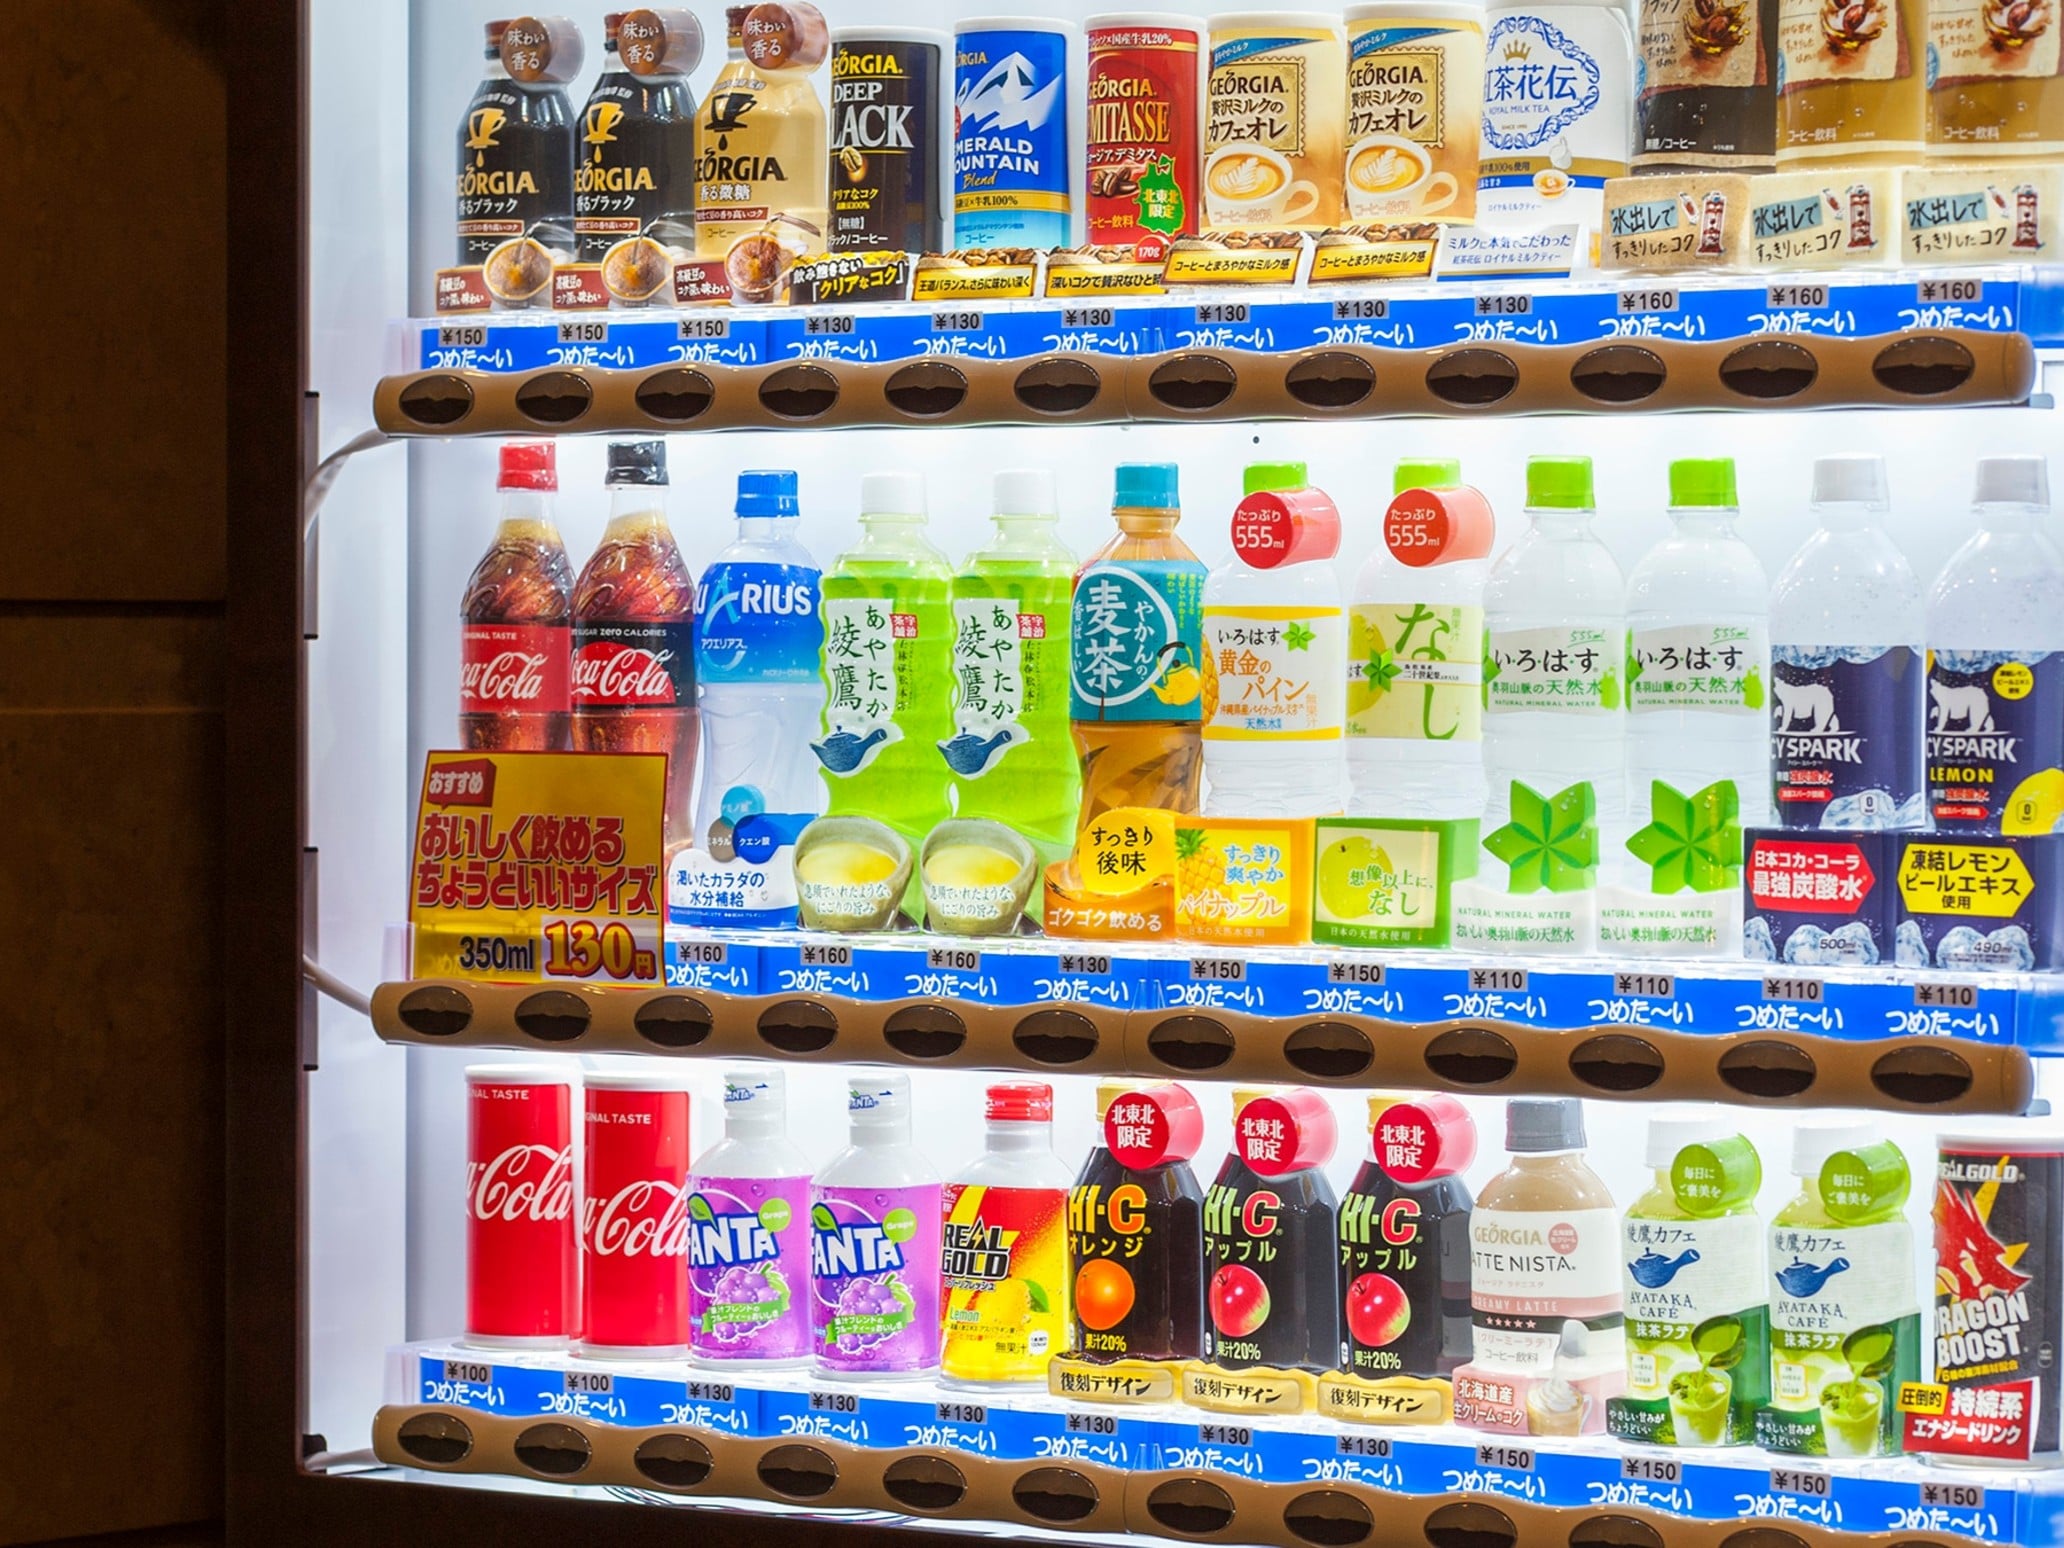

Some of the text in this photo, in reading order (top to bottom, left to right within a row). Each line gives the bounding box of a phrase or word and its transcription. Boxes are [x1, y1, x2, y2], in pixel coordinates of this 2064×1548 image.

[508, 30, 545, 45] 味わい
[624, 23, 659, 38] 味わい
[747, 20, 785, 37] 味わい
[627, 45, 655, 64] 香る
[752, 39, 782, 57] 香る
[512, 53, 540, 70] 香る
[1210, 70, 1285, 95] GEORGIA
[1350, 63, 1424, 88] GEORGIA
[834, 82, 882, 103] DEEP
[1351, 90, 1423, 107] 贅沢ミルクの
[1212, 98, 1284, 116] 贅沢ミルクの
[1511, 105, 1528, 113] MILK
[831, 105, 914, 148] LACK
[1209, 118, 1288, 142] カフェオレ
[1349, 110, 1429, 135] カフェオレ
[963, 171, 997, 190] Blend
[1144, 190, 1178, 203] 北東北
[1148, 204, 1174, 218] 限定
[1139, 247, 1160, 258] 170g
[1320, 250, 1425, 268] コーヒーとまろやかなミルク感
[1772, 287, 1823, 306] ¥160
[1923, 282, 1975, 300] ¥160
[1337, 302, 1385, 317] ¥130
[1480, 297, 1528, 313] ¥130
[1624, 293, 1673, 309] ¥160
[936, 314, 980, 329] ¥130
[1066, 310, 1110, 325] ¥130
[1200, 306, 1245, 321] ¥130
[562, 325, 603, 340] ¥150
[682, 321, 724, 337] ¥150
[808, 318, 851, 334] ¥130
[441, 331, 482, 344] ¥150
[1237, 509, 1281, 523] たっぷり
[1391, 508, 1436, 522] たっぷり
[1236, 525, 1284, 549] 555ml
[1389, 525, 1440, 548] 555ml
[493, 632, 517, 640] TASTE
[600, 628, 621, 636] zero
[1082, 579, 1132, 693] 麦茶
[702, 638, 746, 651] アクエリアス
[828, 615, 864, 711] 綾鷹
[864, 605, 888, 718] あやたか
[955, 615, 990, 712] 綾鷹
[989, 605, 1014, 720] あやたか
[1219, 649, 1271, 676] 黄金の
[1242, 676, 1310, 702] パイン
[1787, 738, 1862, 764] SPARK
[1943, 738, 2016, 763] SPARK
[429, 771, 483, 794] おすすめ
[1930, 768, 1994, 783] LEMON
[419, 814, 623, 864] おいしく飲める
[739, 838, 770, 846] クエン酸
[1092, 827, 1153, 847] すっきり
[1096, 852, 1146, 875] 後味
[1224, 846, 1281, 865] すっきり
[1755, 851, 1860, 871] 日本コカ・コーラ
[1911, 851, 2009, 873] 凍結レモン
[677, 871, 765, 888] 渇いたカラダの
[1226, 865, 1284, 885] 爽やか
[416, 863, 657, 915] ちょうどいいサイズ
[1753, 871, 1864, 900] 最強炭酸水
[1905, 875, 2021, 896] ピールエキス
[690, 891, 744, 907] 水分補給
[1178, 891, 1286, 919] パイナップル
[1369, 890, 1420, 916] なし
[1942, 896, 1971, 909] 使用
[1049, 908, 1163, 932] ゴクゴク飲める
[1538, 911, 1571, 919] WATER
[1331, 926, 1411, 941] 日本の天然水使用
[459, 920, 656, 980] 350ml 130円
[680, 946, 722, 961] ¥160
[804, 948, 847, 963] ¥160
[932, 951, 975, 969] ¥160
[1062, 956, 1108, 973] ¥130
[1194, 961, 1240, 978] ¥150
[1333, 964, 1380, 981] ¥150
[1474, 971, 1522, 988] ¥110
[1619, 976, 1669, 994] ¥110
[1768, 980, 1818, 998] ¥110
[1919, 986, 1972, 1004] ¥110
[492, 1089, 529, 1099] TASTE
[612, 1113, 651, 1124] TASTE
[1112, 1105, 1155, 1124] 北東北
[1117, 1126, 1152, 1149] 限定
[1242, 1119, 1284, 1139] 北東北
[1381, 1125, 1425, 1145] 北東北
[1247, 1140, 1281, 1161] 限定
[1387, 1146, 1422, 1168] 限定
[1684, 1167, 1715, 1180] 毎日に
[1832, 1174, 1864, 1187] 毎日に
[1678, 1184, 1721, 1198] ご褒美を
[689, 1217, 776, 1265] ANTA
[944, 1216, 1008, 1252] REAL
[812, 1227, 900, 1275] ANTA
[1069, 1236, 1143, 1257] オレンジ
[1205, 1241, 1276, 1262] アップル
[942, 1251, 1008, 1278] GOLD
[1341, 1245, 1417, 1270] アップル
[1517, 1300, 1558, 1312] LATTE
[1630, 1293, 1692, 1308] AYATAKA
[1778, 1300, 1845, 1317] AYATAKA
[951, 1308, 979, 1322] Lemon
[1636, 1322, 1690, 1338] 抹茶ラテ
[996, 1342, 1026, 1353] 無果汁
[1085, 1334, 1126, 1351] 果汁20%
[1217, 1340, 1261, 1360] 果汁20%
[1784, 1333, 1842, 1349] 抹茶ラテ
[1936, 1325, 2021, 1368] BOOST
[1355, 1350, 1401, 1369] 果汁20%
[1485, 1349, 1538, 1363] コーヒー飲料
[448, 1363, 487, 1383] ¥100
[568, 1373, 609, 1391] ¥100
[690, 1382, 731, 1402] ¥130
[1061, 1373, 1152, 1396] 復刻デザイン
[1194, 1378, 1282, 1402] 復刻デザイン
[1459, 1378, 1513, 1404] 北海道産
[812, 1393, 856, 1412] ¥130
[1331, 1387, 1424, 1412] 復刻デザイン
[1950, 1389, 2023, 1419] 持続系
[939, 1404, 983, 1423] ¥130
[1069, 1414, 1114, 1434] ¥130
[1912, 1419, 2021, 1444] エナジードリンク
[1203, 1425, 1249, 1444] ¥130
[1341, 1436, 1388, 1457] ¥130
[1481, 1447, 1530, 1469] ¥150
[1627, 1460, 1677, 1481] ¥150
[1775, 1473, 1826, 1494] ¥150
[1925, 1486, 1977, 1506] ¥150
